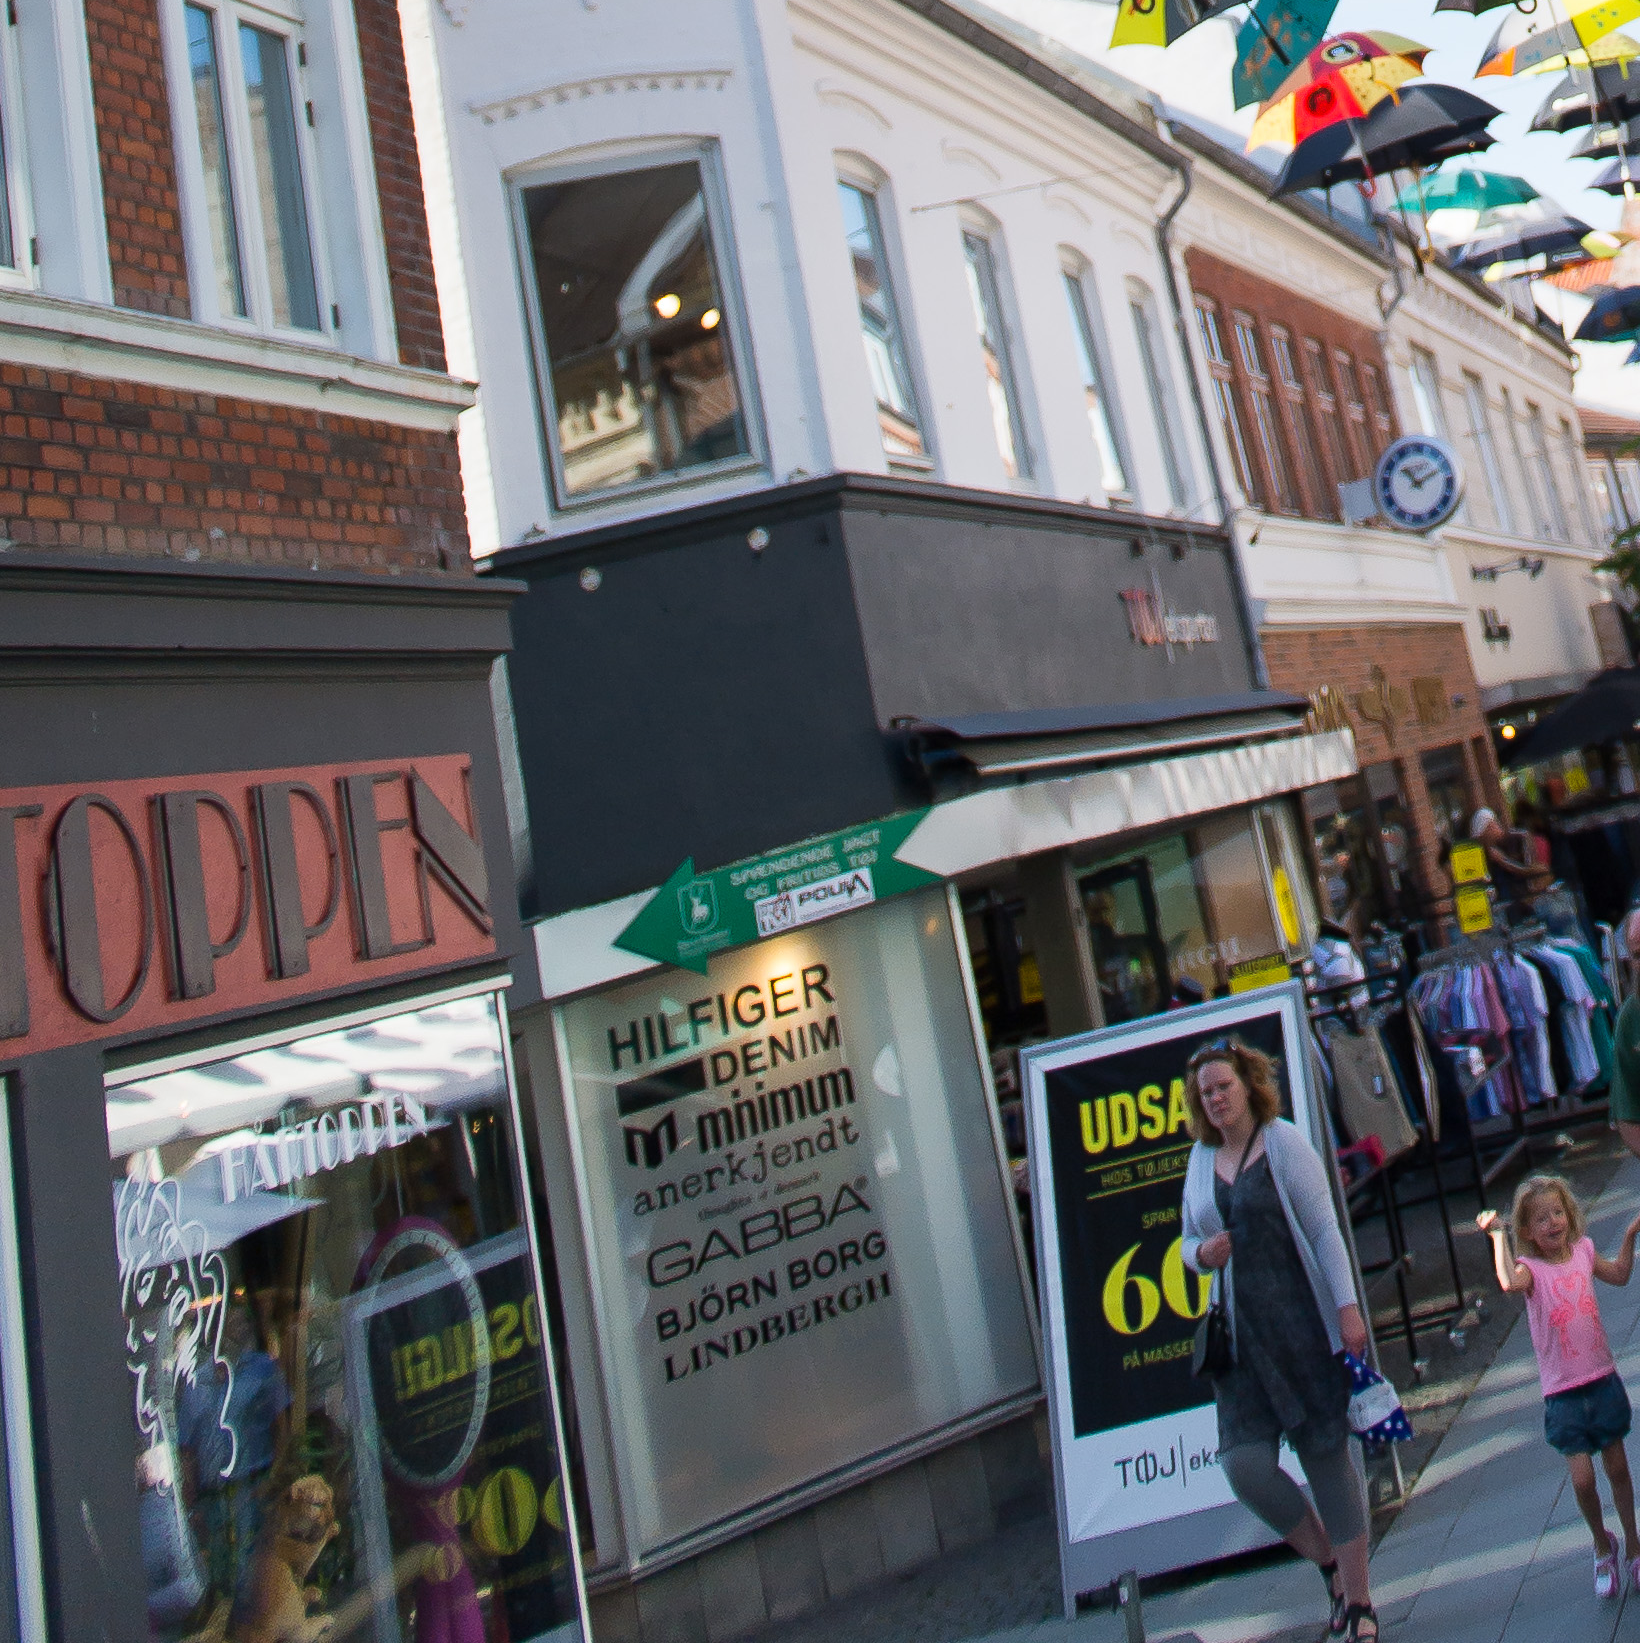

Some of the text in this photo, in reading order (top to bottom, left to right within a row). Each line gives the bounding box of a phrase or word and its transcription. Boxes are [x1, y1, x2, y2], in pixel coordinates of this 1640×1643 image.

[606, 962, 837, 1072] HILFIGER
[710, 1014, 842, 1086] DENIM
[696, 1066, 858, 1154] minimum
[1079, 1076, 1192, 1155] UDSA
[633, 1115, 860, 1216] anerkjendt
[646, 1180, 872, 1288] GABBA
[655, 1228, 887, 1342] BJÖRN BORG
[663, 1270, 893, 1384] LINDBERGH
